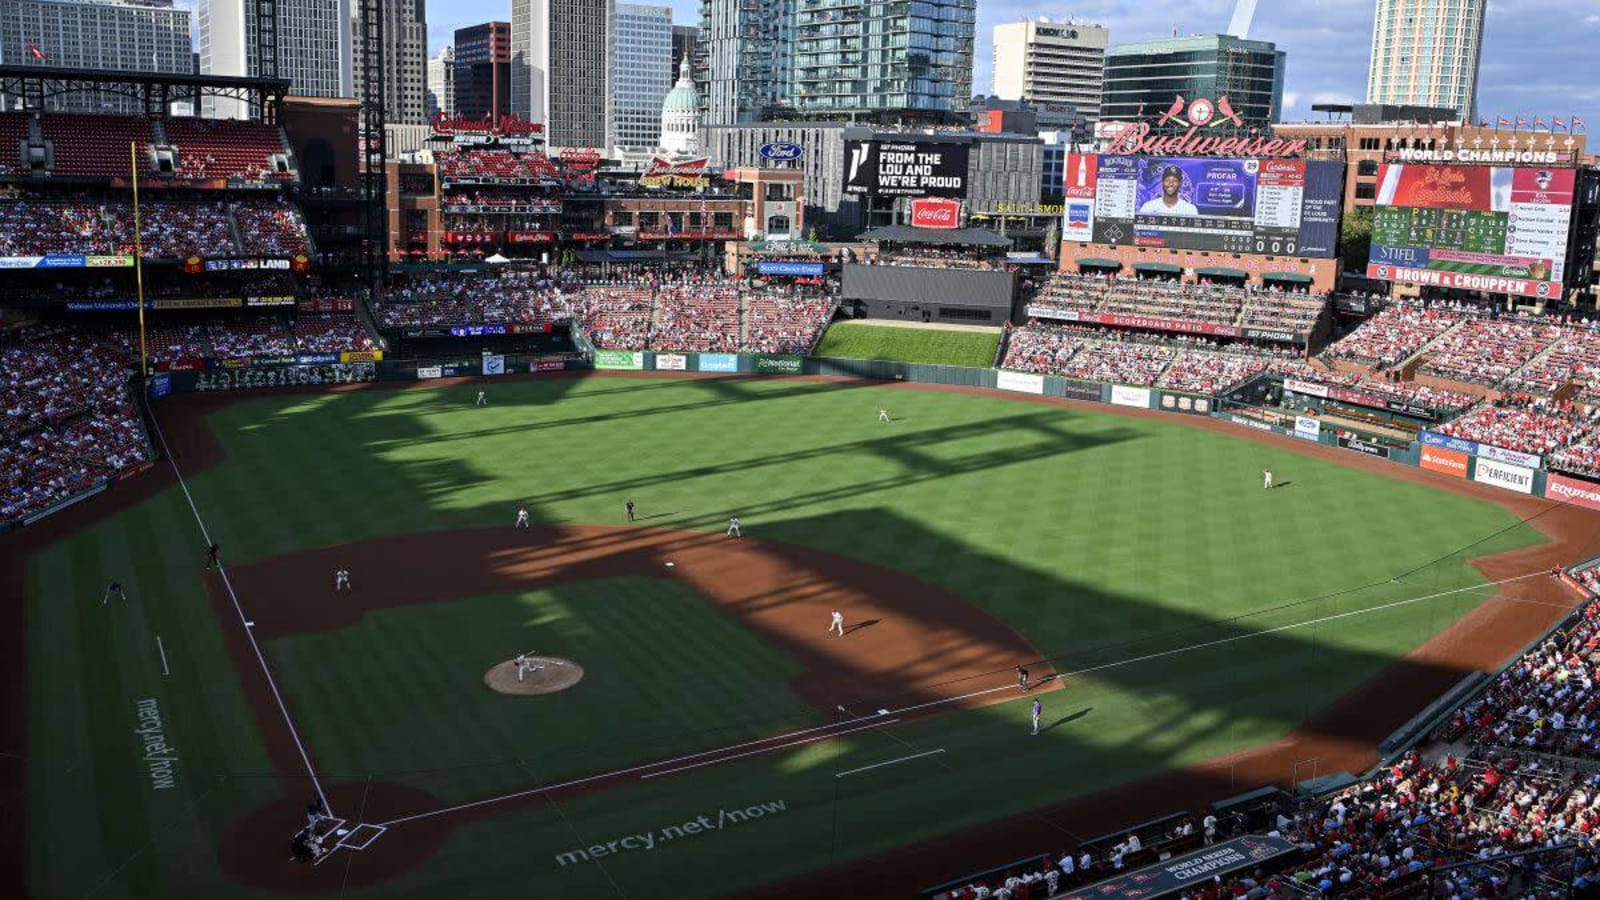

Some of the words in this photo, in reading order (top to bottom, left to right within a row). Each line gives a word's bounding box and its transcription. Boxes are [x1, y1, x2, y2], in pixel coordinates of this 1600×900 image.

[1102, 122, 1307, 155] Budweiser
[767, 145, 797, 158] Ford
[880, 152, 915, 164] FROM
[917, 153, 942, 164] THE
[1400, 149, 1456, 161] WORLD
[1457, 150, 1557, 162] CHAMPIONS
[879, 164, 903, 175] LOU
[905, 165, 932, 176] AND
[1266, 161, 1297, 172] Cardinals
[639, 177, 670, 186] BREW
[673, 177, 710, 187] HOUSE
[879, 176, 917, 187] WE'RE
[920, 176, 962, 188] PROUD
[1206, 172, 1238, 180] PROFAR
[917, 208, 951, 221] Coca-Cola
[1256, 241, 1264, 251] 0
[1272, 242, 1280, 252] 0
[1287, 242, 1295, 253] 0
[1380, 246, 1418, 262] STIFEL
[1395, 268, 1440, 284] BROWN
[1442, 274, 1451, 285] &
[1454, 272, 1527, 293] CROUPPEN
[1113, 317, 1172, 329] SCOREBOARD
[1174, 322, 1203, 331] PATIO
[1261, 331, 1293, 341] PHORM
[768, 359, 801, 368] National
[1477, 463, 1530, 487] PERFICIENT
[135, 698, 179, 790] mercy.net/now
[555, 799, 788, 867] mercy.net/now
[1165, 858, 1204, 873] WORLD
[1174, 852, 1246, 880] CHAMPIONS
